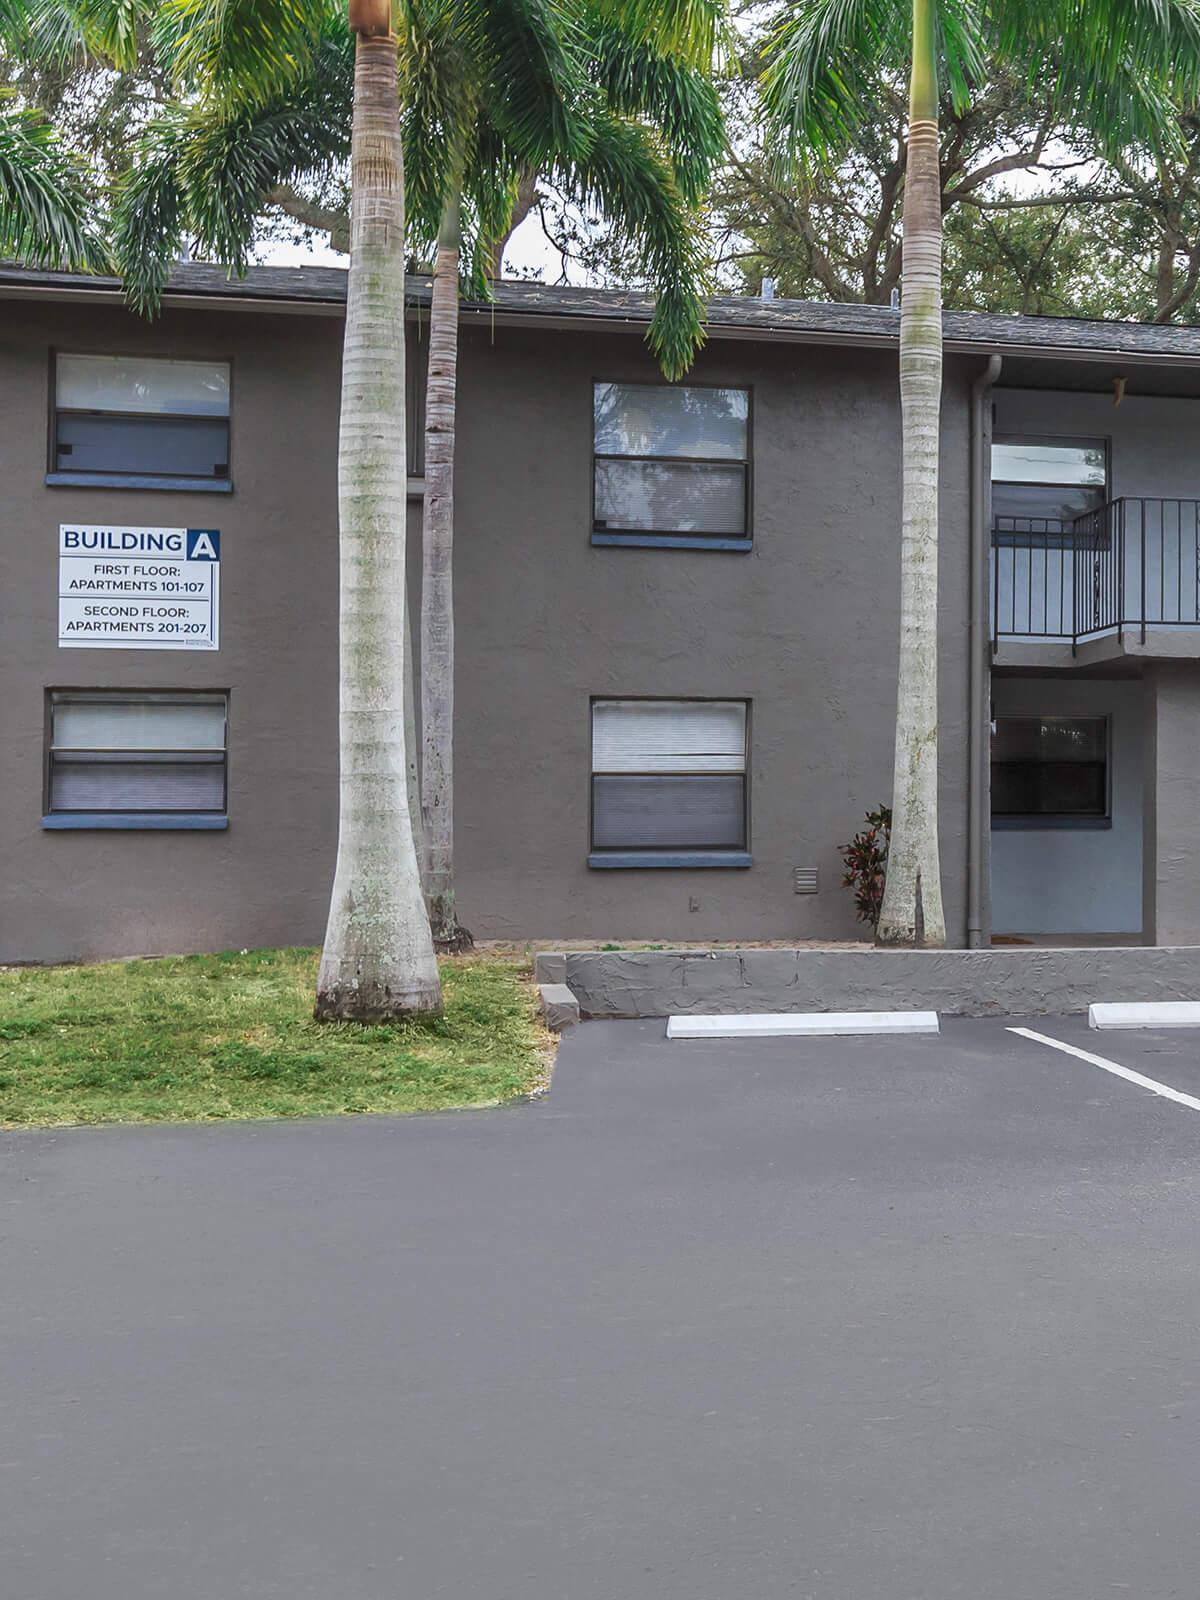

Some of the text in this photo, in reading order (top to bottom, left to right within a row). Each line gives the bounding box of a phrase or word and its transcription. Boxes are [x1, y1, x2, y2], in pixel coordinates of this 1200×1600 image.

[65, 531, 217, 558] BUILDING A
[94, 564, 181, 576] FIRST FLOOR:
[69, 580, 205, 592] APARTMENTS 101-107
[84, 606, 190, 618] SECOND FLOOR:
[66, 621, 206, 633] APARTMENTS 201-207
